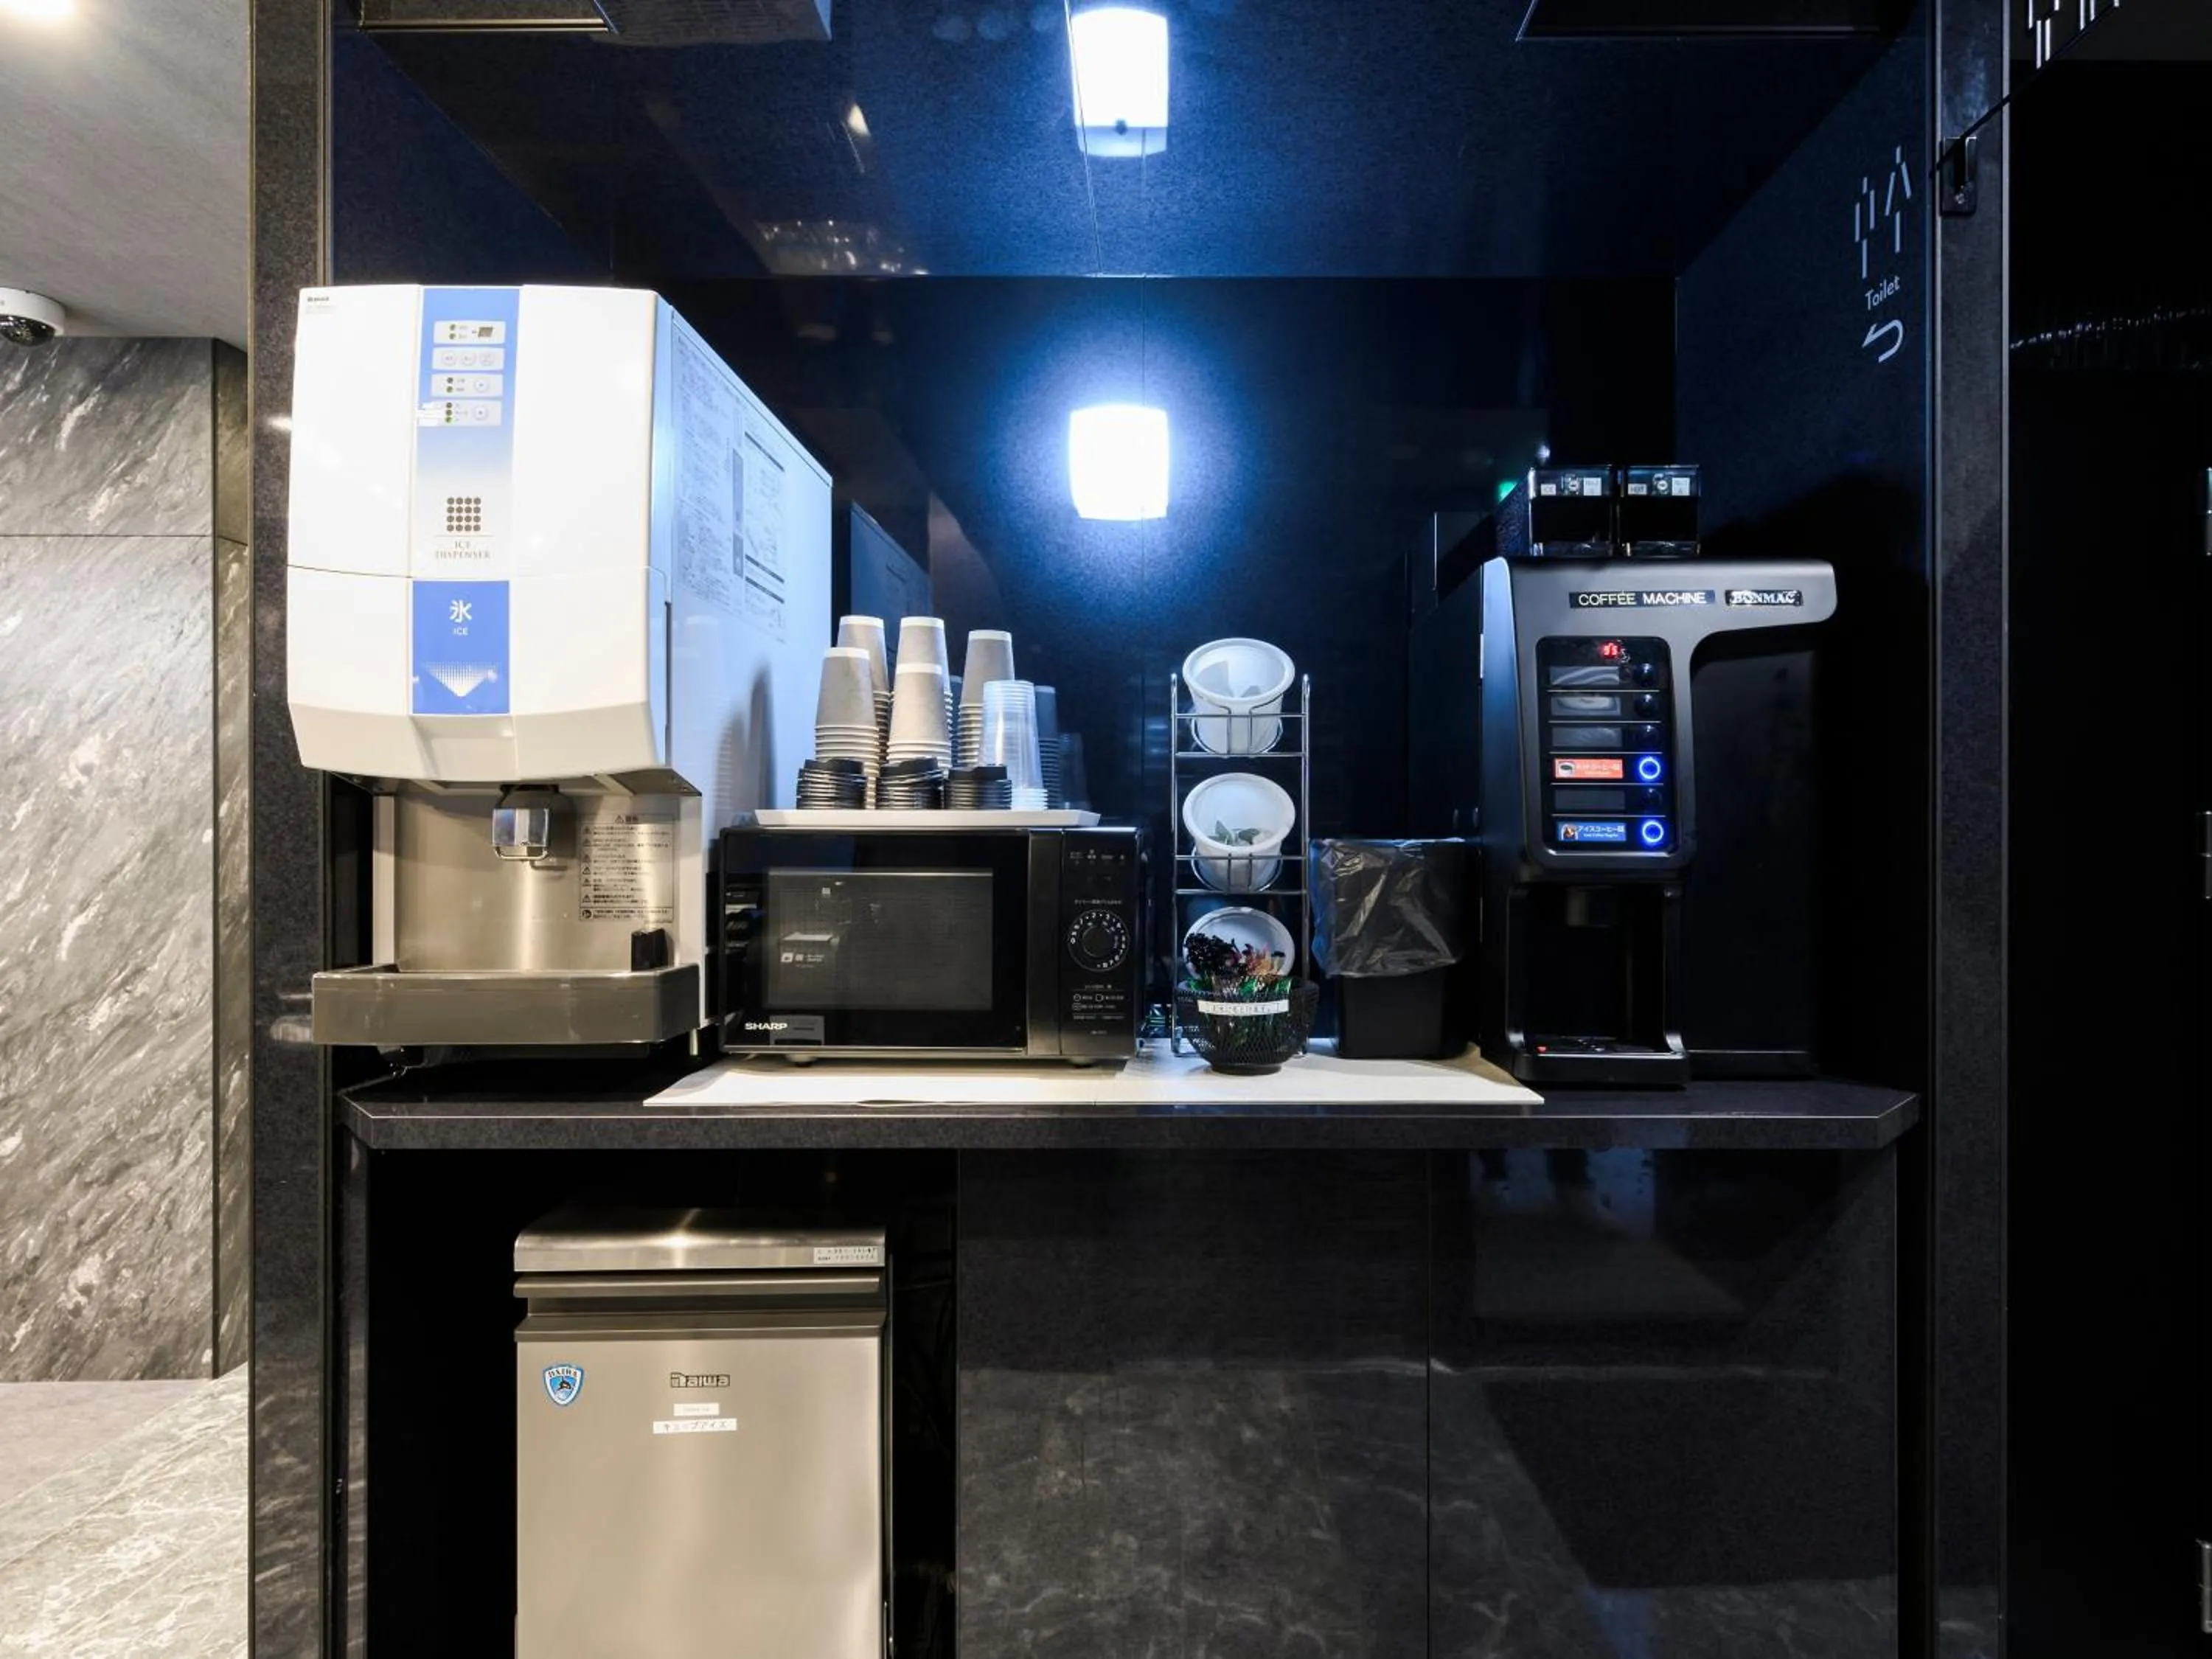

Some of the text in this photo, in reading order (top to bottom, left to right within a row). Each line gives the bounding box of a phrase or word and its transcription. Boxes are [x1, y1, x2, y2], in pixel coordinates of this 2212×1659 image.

[1865, 275, 1900, 310] Toilet
[454, 540, 471, 550] ICE
[435, 551, 491, 560] DISPENSER
[1579, 591, 1706, 606] COFFEE MACHINE
[1731, 591, 1797, 605] BONMAC
[448, 599, 473, 623] 氷
[453, 627, 468, 636] ICE
[744, 1022, 788, 1030] SHARP
